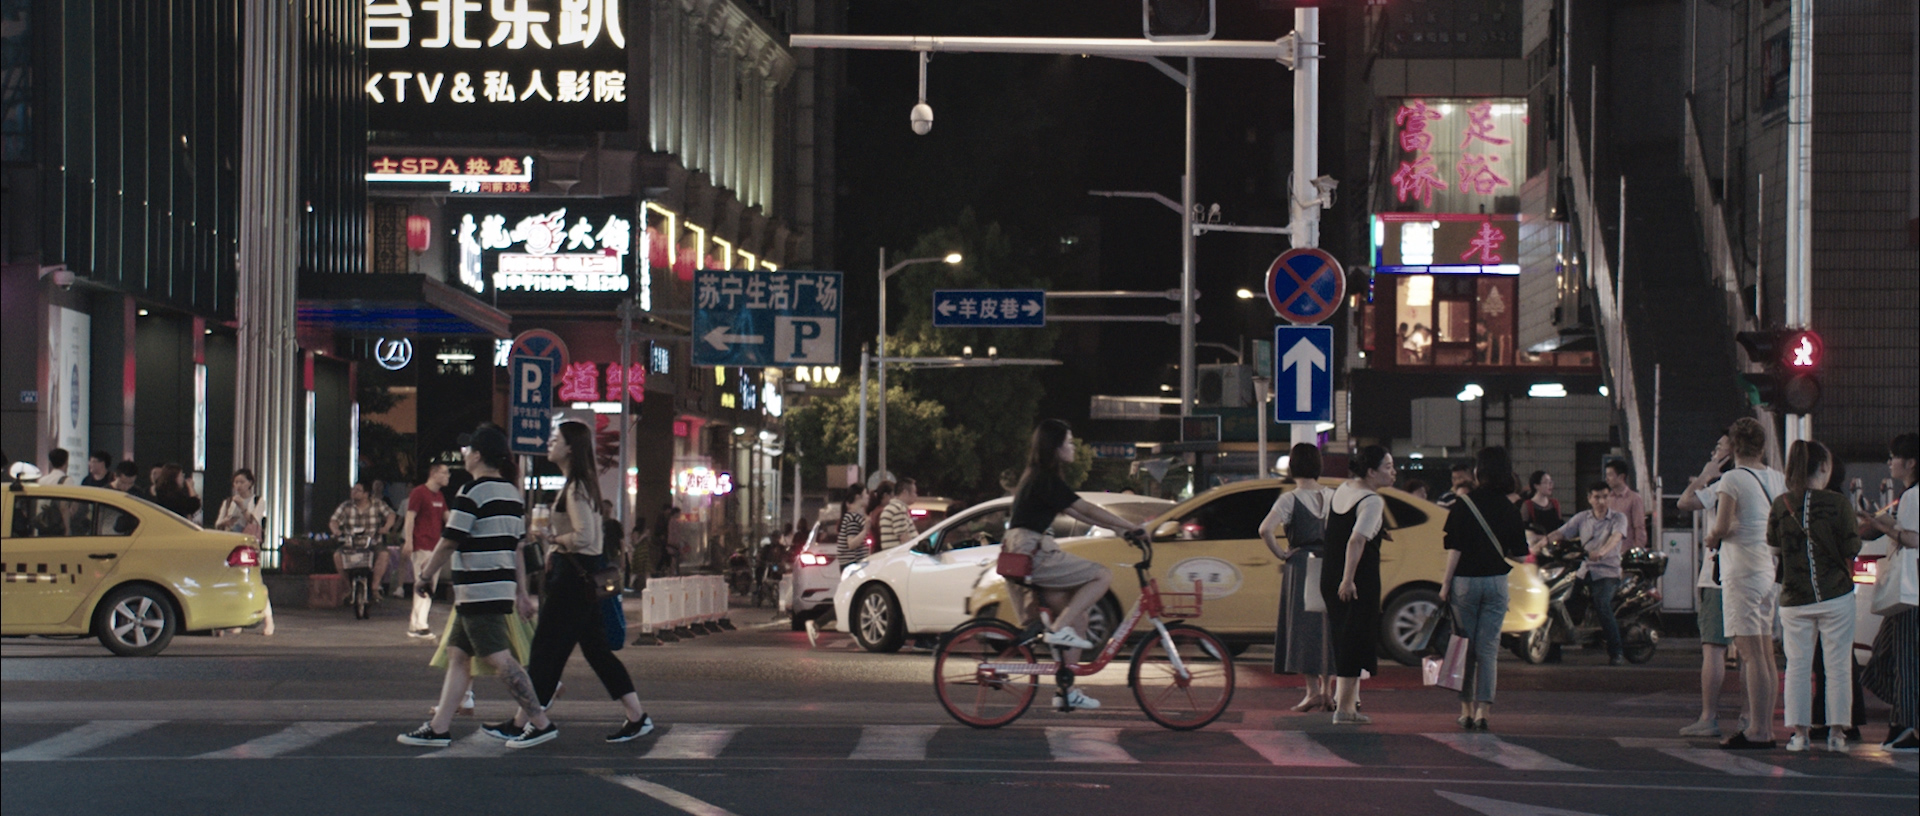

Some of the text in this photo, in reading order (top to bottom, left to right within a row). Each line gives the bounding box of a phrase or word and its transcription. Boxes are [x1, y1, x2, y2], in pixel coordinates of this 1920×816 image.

[1462, 222, 1506, 264] 老
[698, 273, 838, 312] 苏宁生活广场
[958, 298, 1020, 319] 羊皮巷
[790, 320, 821, 359] P
[521, 362, 543, 404] P
